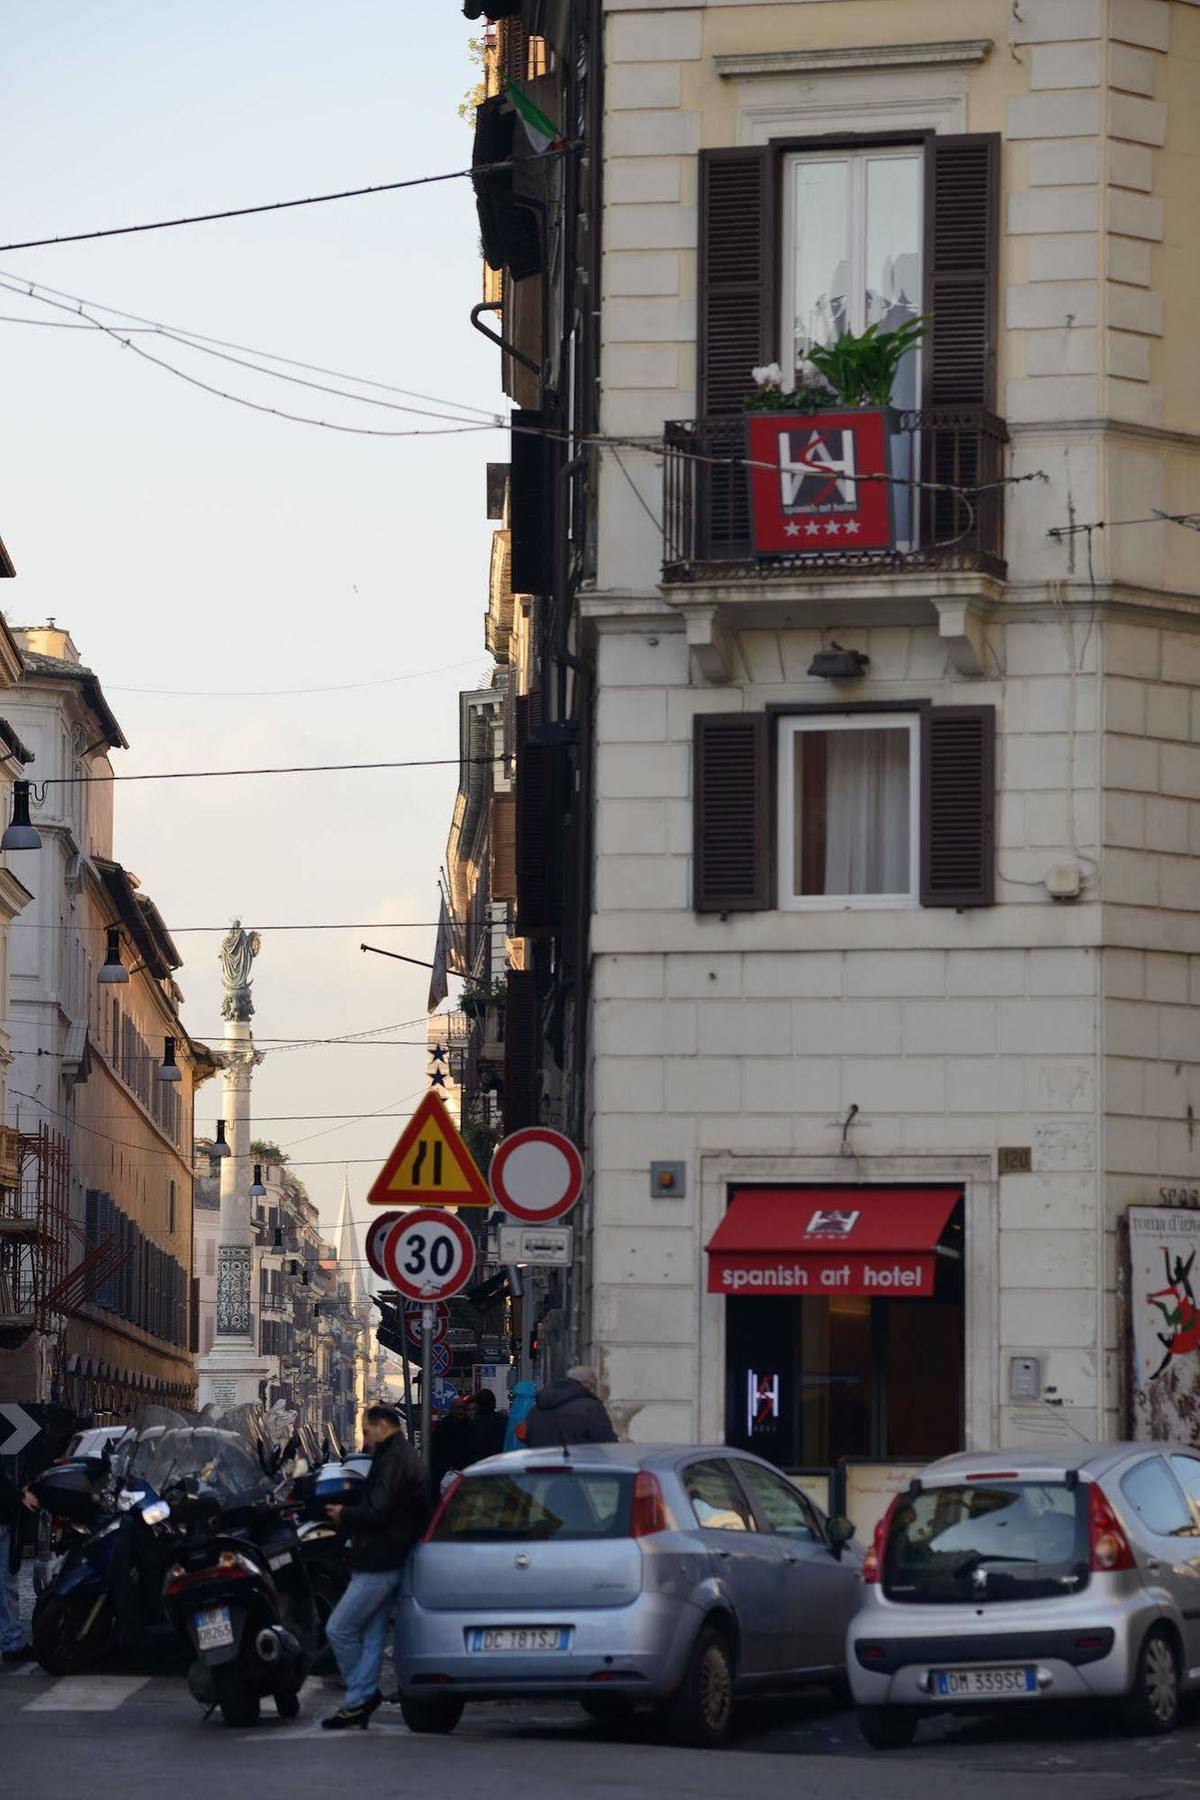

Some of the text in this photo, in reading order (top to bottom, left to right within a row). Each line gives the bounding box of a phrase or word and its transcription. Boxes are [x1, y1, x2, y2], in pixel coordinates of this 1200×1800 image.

[819, 503, 831, 513] art
[833, 502, 857, 513] hotel
[404, 1234, 455, 1276] 30
[722, 1264, 922, 1289] spanish art hotel
[484, 1630, 559, 1649] DC 181SJ
[975, 1672, 1023, 1691] 339SC
